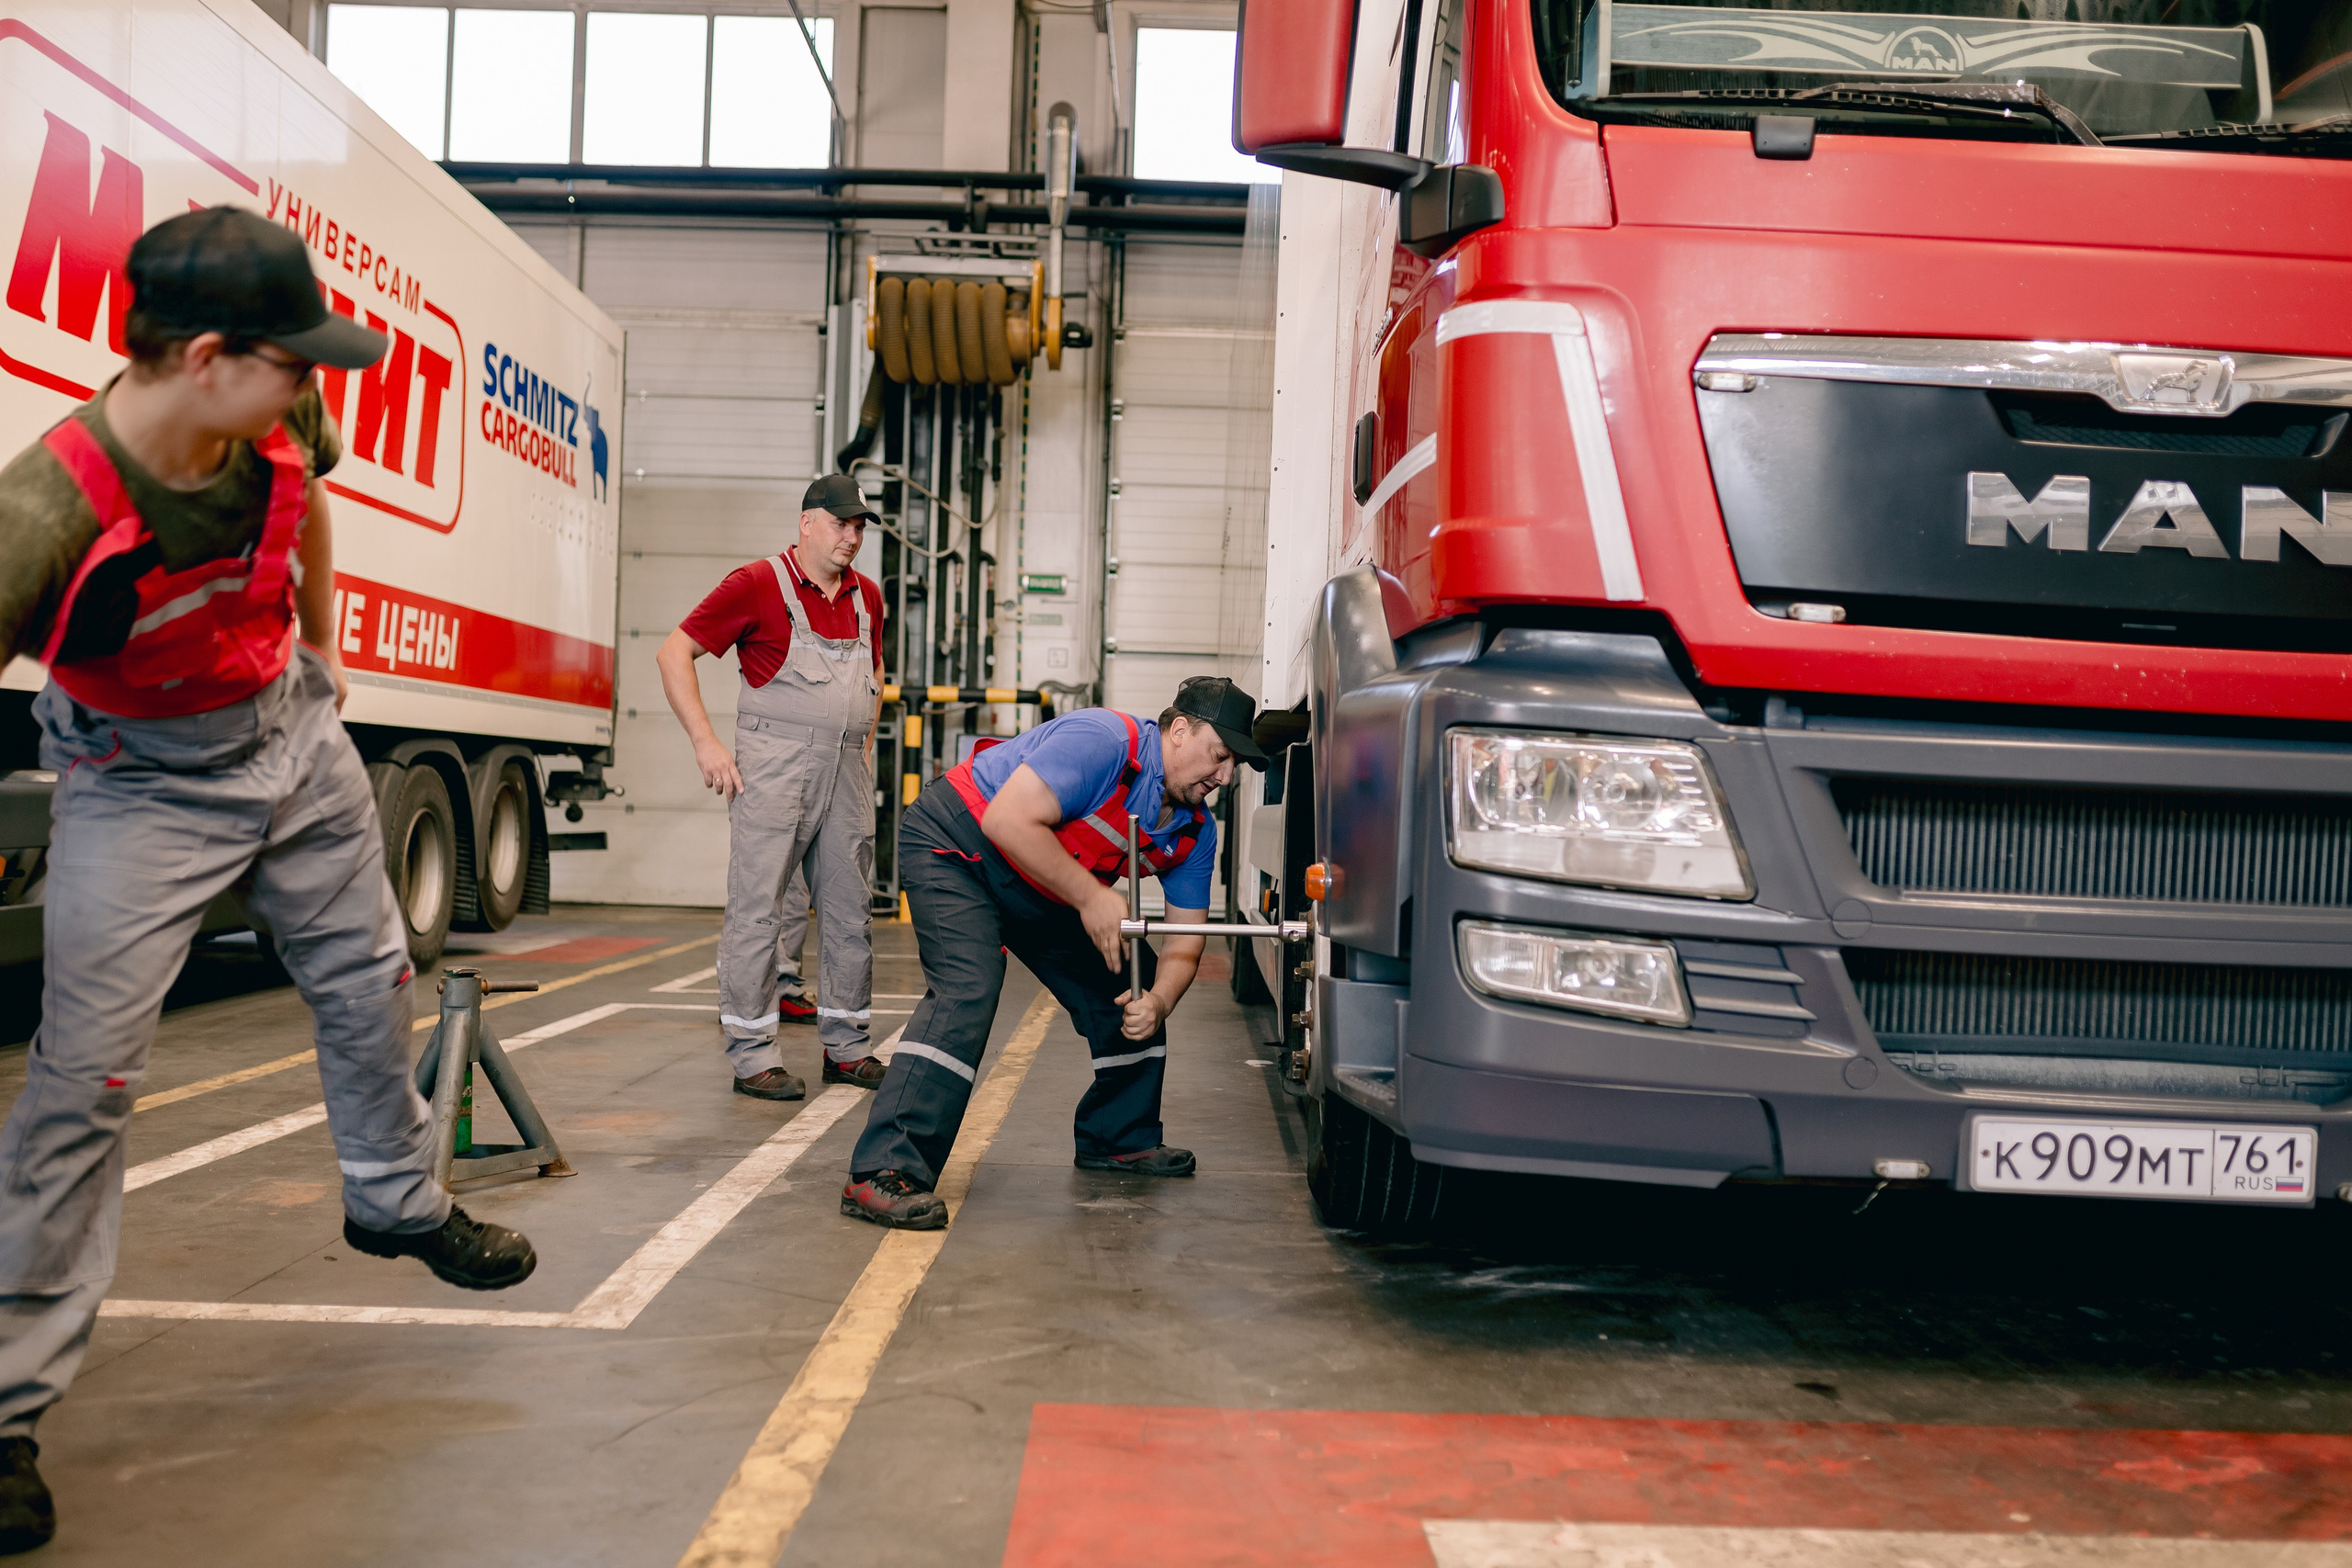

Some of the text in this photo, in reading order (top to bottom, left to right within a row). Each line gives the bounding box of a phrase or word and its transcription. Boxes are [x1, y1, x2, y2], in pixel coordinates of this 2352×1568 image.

[1893, 56, 1957, 72] MAN
[266, 176, 422, 316] УНИВЕРСАМ
[483, 343, 579, 448] SCHMITZ
[481, 400, 577, 489] CARGOBULL
[1966, 470, 2352, 567] MAN
[376, 600, 460, 671] ЦЕНЫ
[2219, 1134, 2298, 1176] 761
[2234, 1176, 2274, 1191] RUS
